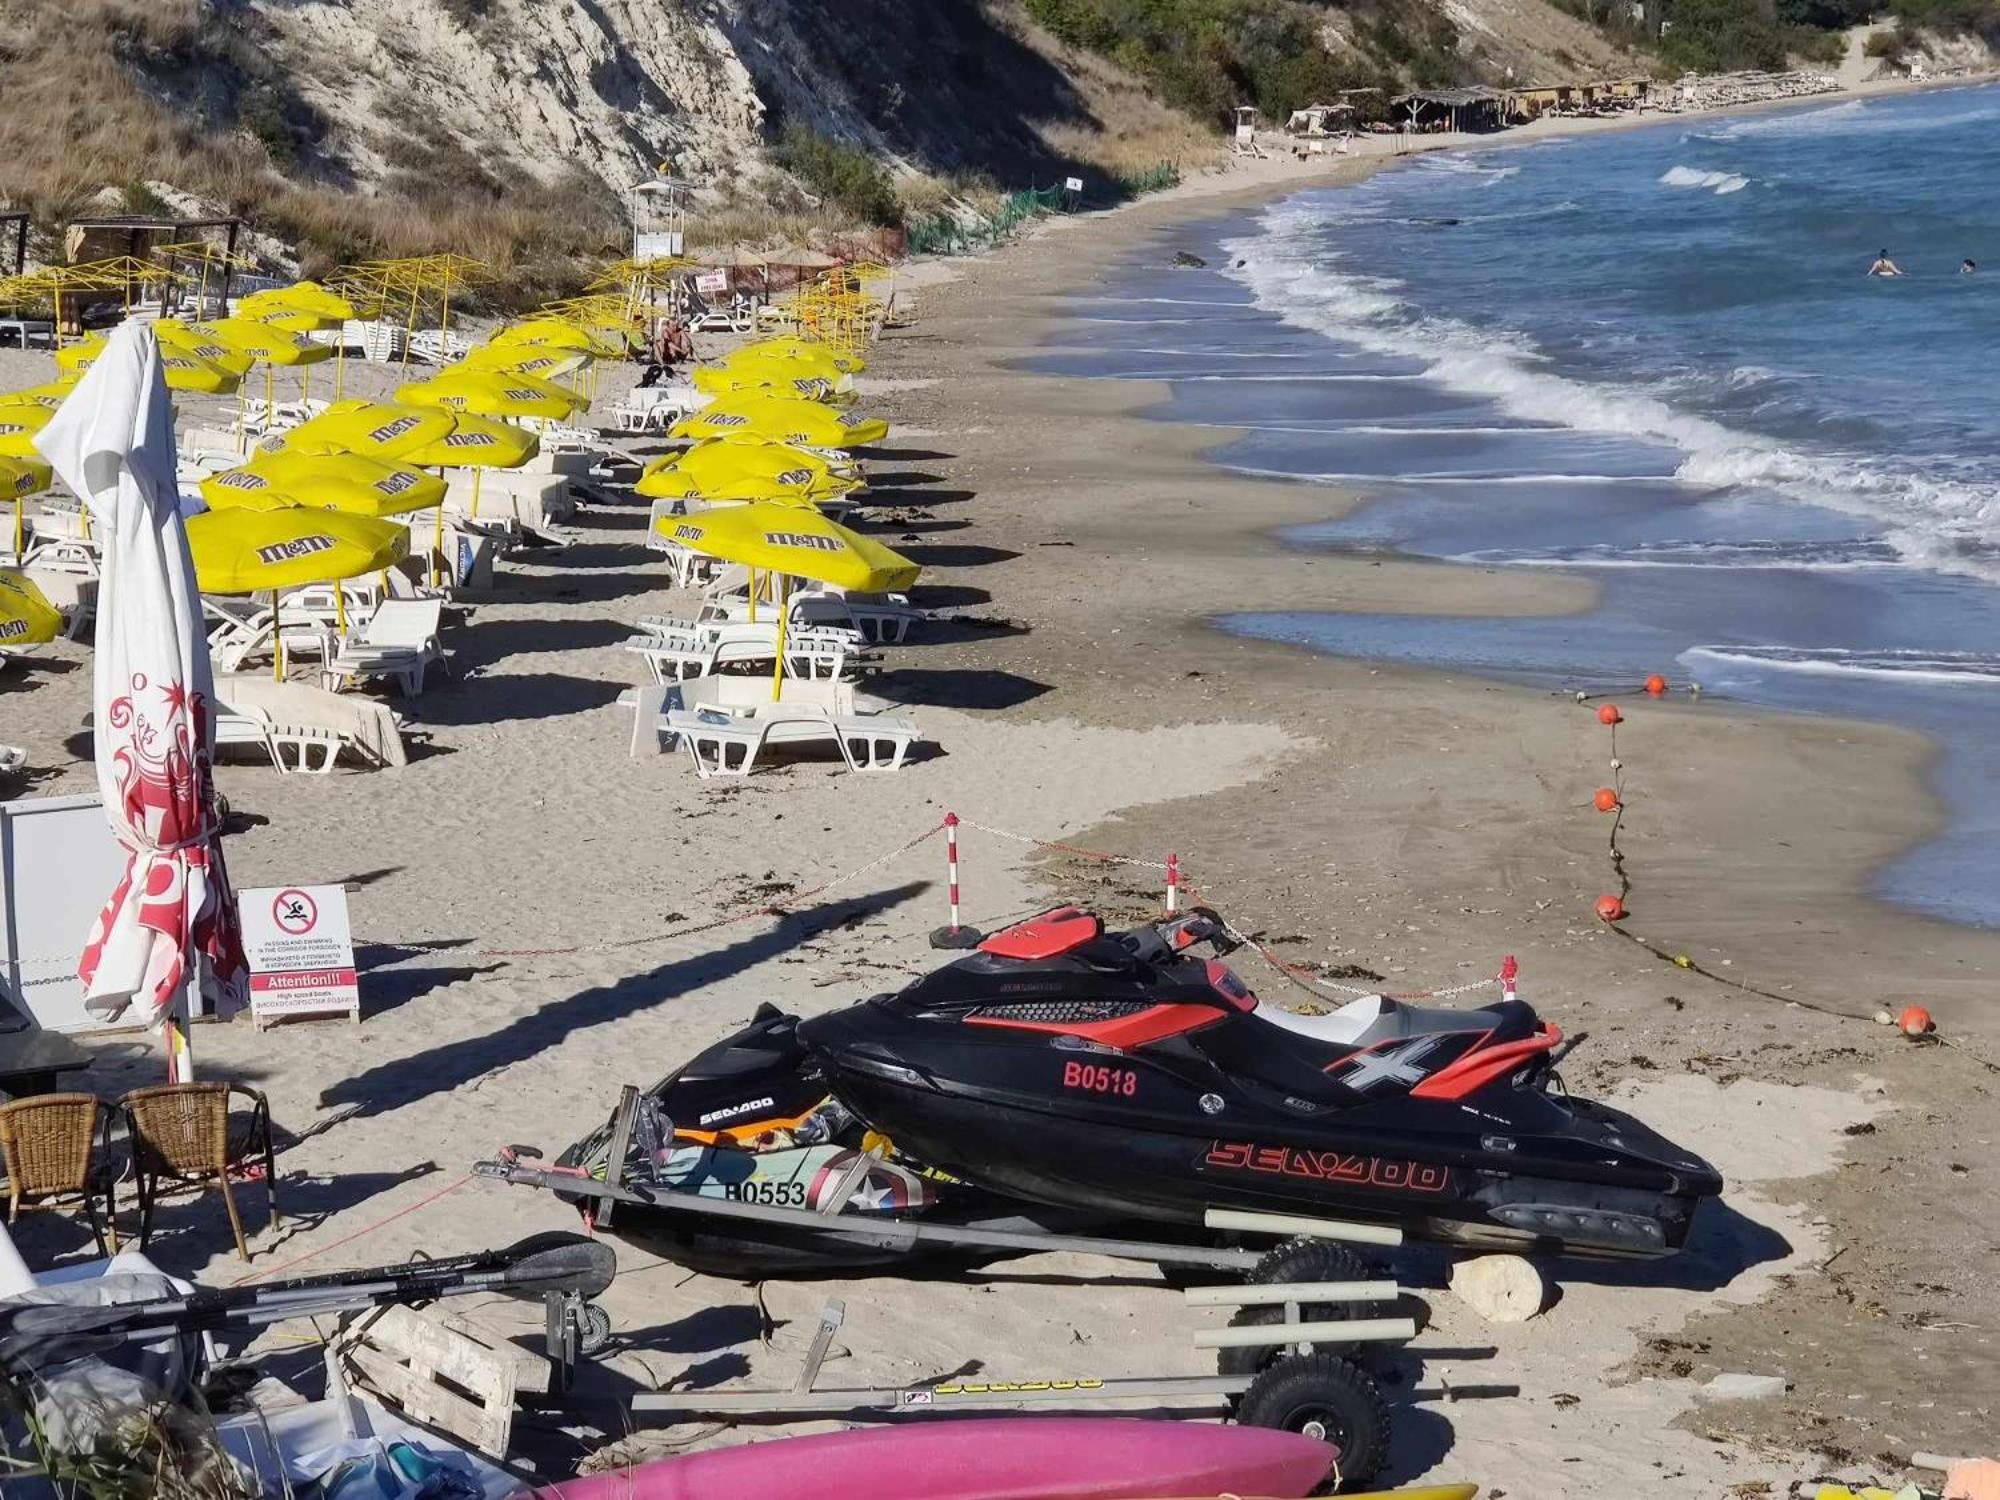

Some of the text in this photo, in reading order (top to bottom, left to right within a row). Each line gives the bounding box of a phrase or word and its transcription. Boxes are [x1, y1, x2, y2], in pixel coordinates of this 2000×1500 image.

[267, 973, 341, 989] Attention!!!
[1064, 1061, 1137, 1095] B0518
[726, 1181, 806, 1205] B0553
